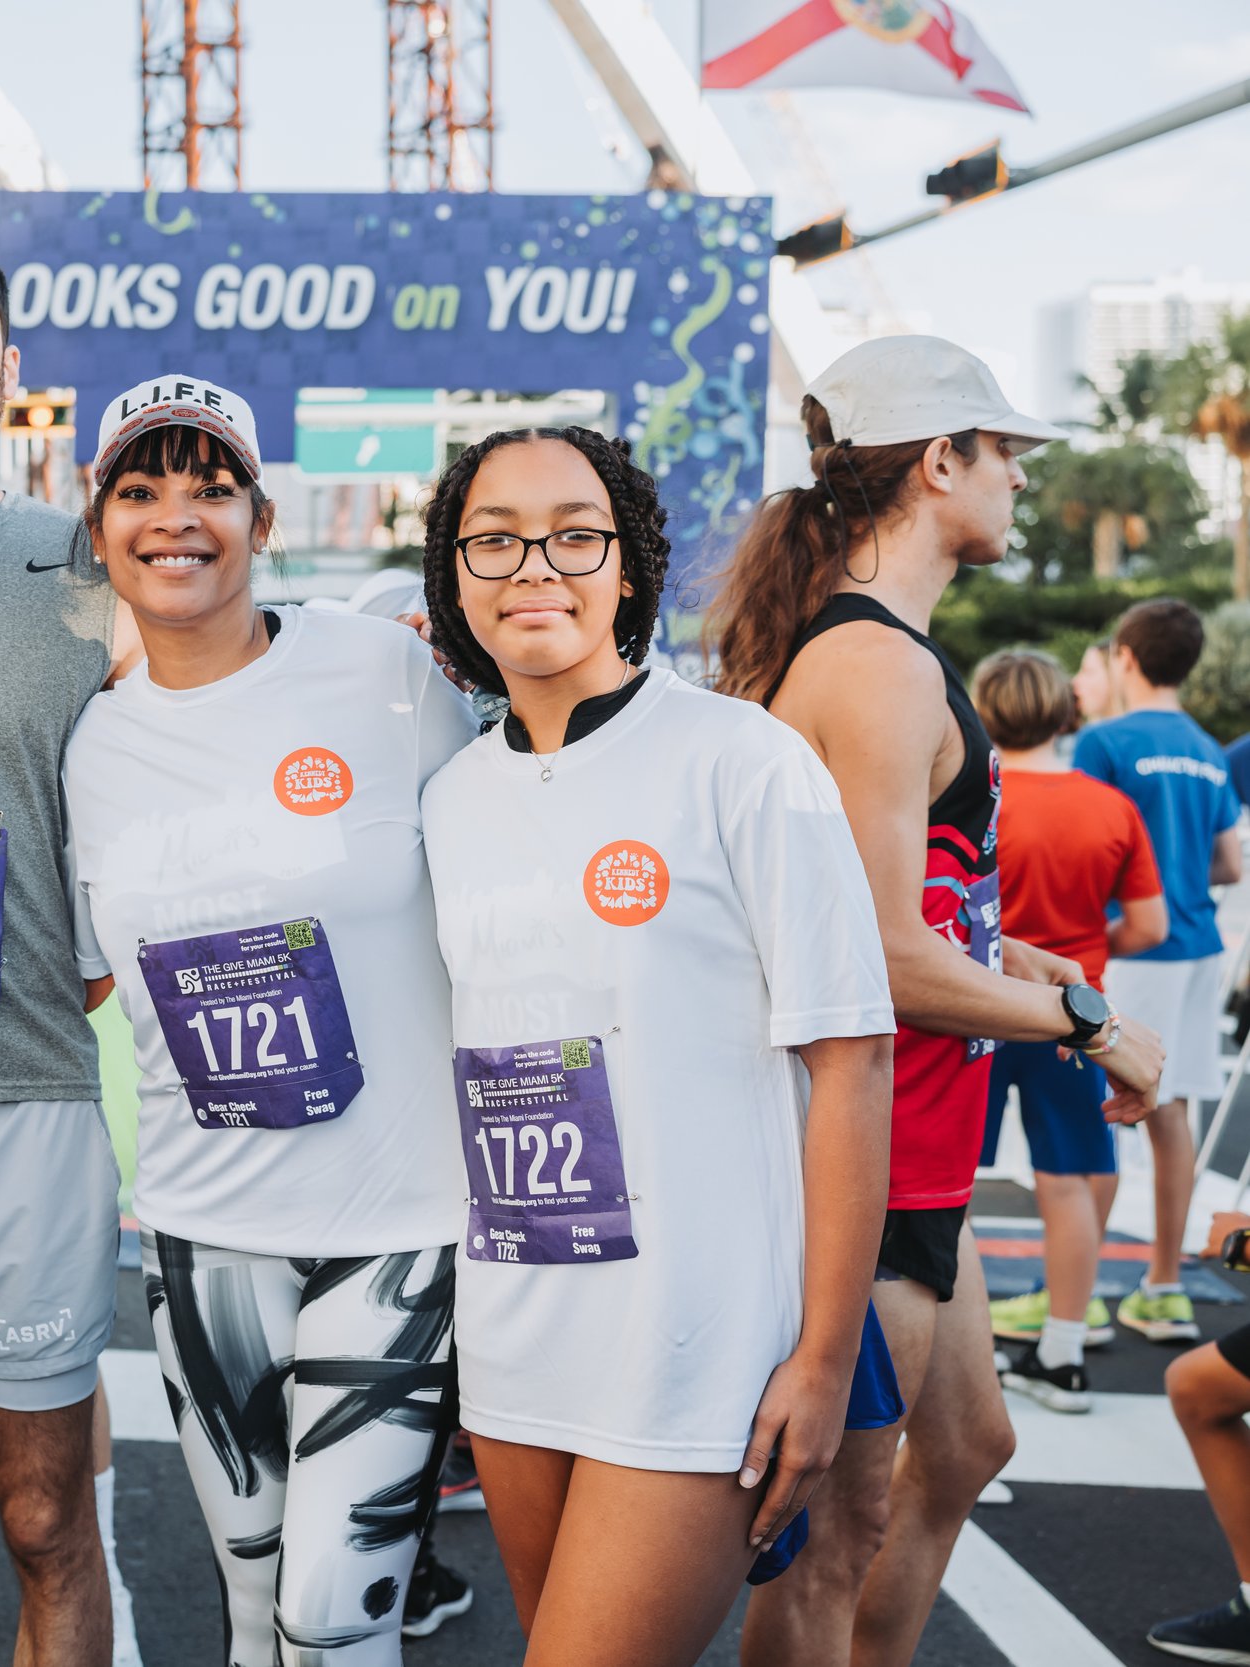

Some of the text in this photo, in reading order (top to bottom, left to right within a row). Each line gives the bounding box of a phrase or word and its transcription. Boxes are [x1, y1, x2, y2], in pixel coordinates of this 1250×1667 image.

[12, 262, 181, 331] OOKS
[193, 262, 377, 331] GOOD
[392, 283, 461, 331] on
[485, 264, 638, 335] YOU!
[121, 382, 234, 423] L.I.F.E.
[295, 776, 333, 790] KIDS
[604, 876, 646, 892] KIDS
[264, 932, 279, 940] code
[250, 943, 264, 951] your
[264, 939, 287, 948] results!
[201, 952, 292, 975] THE GIVE MIAMI 5K
[200, 998, 218, 1007] Hosted
[218, 997, 226, 1006] by
[236, 994, 253, 1002] Miami
[252, 988, 283, 999] Foundation
[186, 996, 319, 1072] 1721
[513, 1048, 555, 1060] Scan the code
[274, 1067, 285, 1075] find
[285, 1066, 299, 1075] your
[299, 1062, 320, 1071] cause.
[524, 1060, 538, 1069] your
[538, 1057, 561, 1066] results!
[481, 1072, 566, 1090] THE GIVE MIAMI 5K
[303, 1088, 330, 1101] Free
[207, 1101, 336, 1117] Gear Check Swag
[219, 1112, 250, 1127] 1721
[494, 1115, 501, 1124] by
[500, 1114, 509, 1122] The
[509, 1114, 524, 1122] Miami
[524, 1111, 555, 1121] Foundation
[475, 1121, 592, 1196] 1722
[544, 1197, 555, 1205] find
[555, 1197, 569, 1206] your
[569, 1195, 589, 1203] cause.
[489, 1228, 527, 1243] Gear Check
[571, 1225, 595, 1238] Free
[496, 1241, 520, 1262] 1722
[572, 1242, 602, 1256] Swag
[6, 1318, 66, 1345] ASRV
